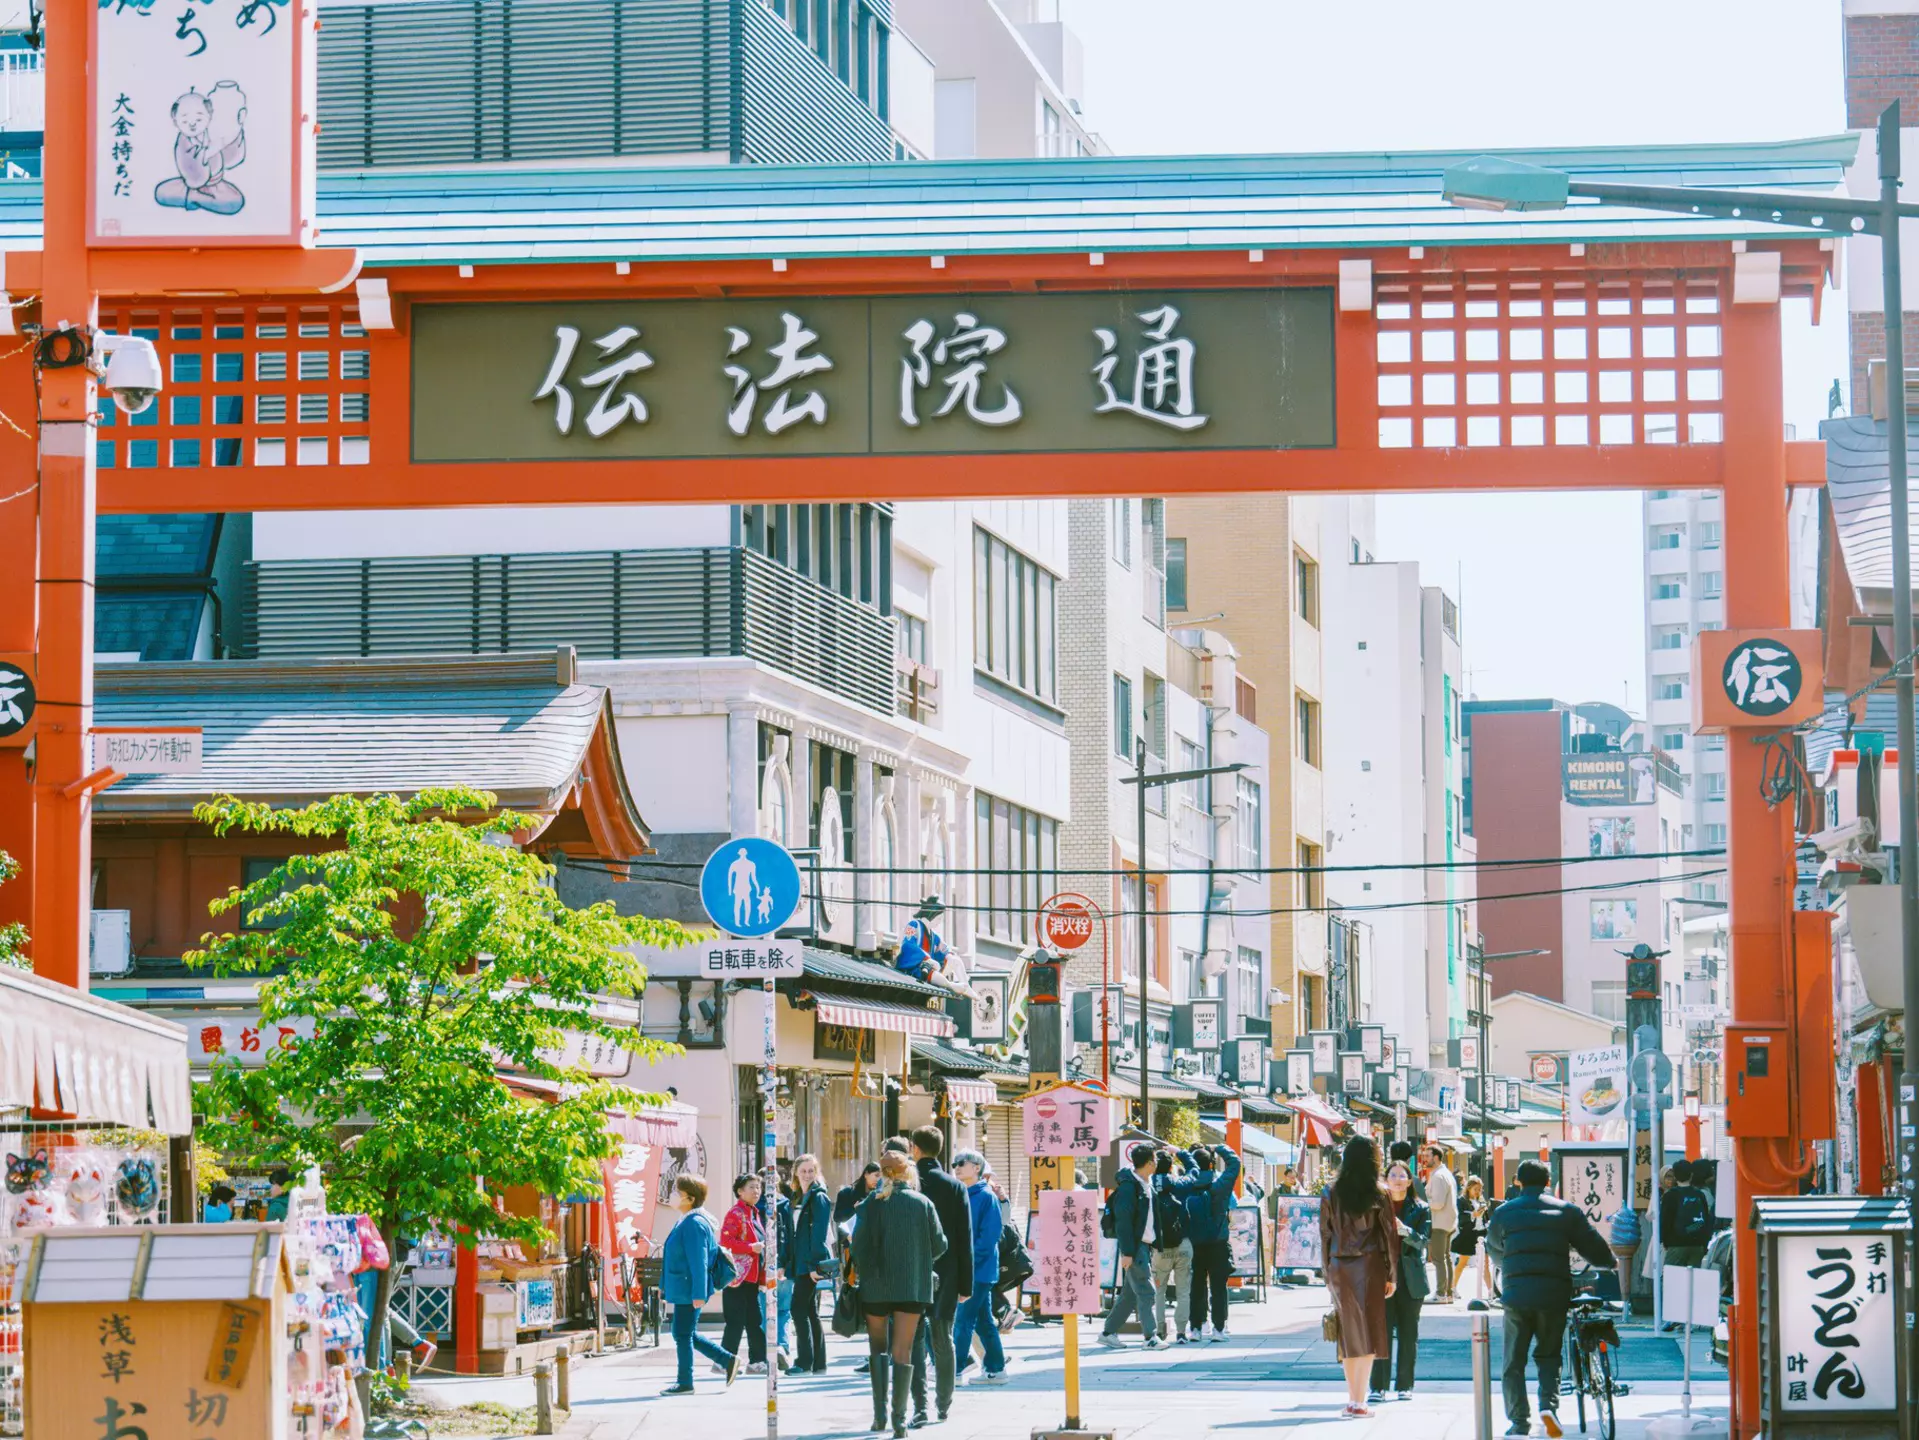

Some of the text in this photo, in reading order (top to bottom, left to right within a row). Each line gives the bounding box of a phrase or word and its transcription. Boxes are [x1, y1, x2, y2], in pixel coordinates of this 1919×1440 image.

[110, 92, 135, 197] 大金持ちだ
[534, 303, 1210, 437] 伝法院通
[1727, 647, 1791, 706] 伝
[106, 737, 192, 763] 防犯カメラ作動中
[1567, 761, 1625, 773] KIMONO
[1569, 779, 1624, 790] RENTAL
[1050, 916, 1089, 936] 消火栓
[709, 948, 794, 970] 自転車を除く
[1573, 1069, 1597, 1078] Ramen
[1032, 1122, 1045, 1152] 通行止
[1069, 1099, 1099, 1152] 下馬
[1584, 1161, 1602, 1223] らーめん
[1866, 1241, 1887, 1294] 手打
[98, 1313, 136, 1384] 浅草
[1807, 1247, 1864, 1400] うどん
[1787, 1352, 1808, 1401] 叶屋
